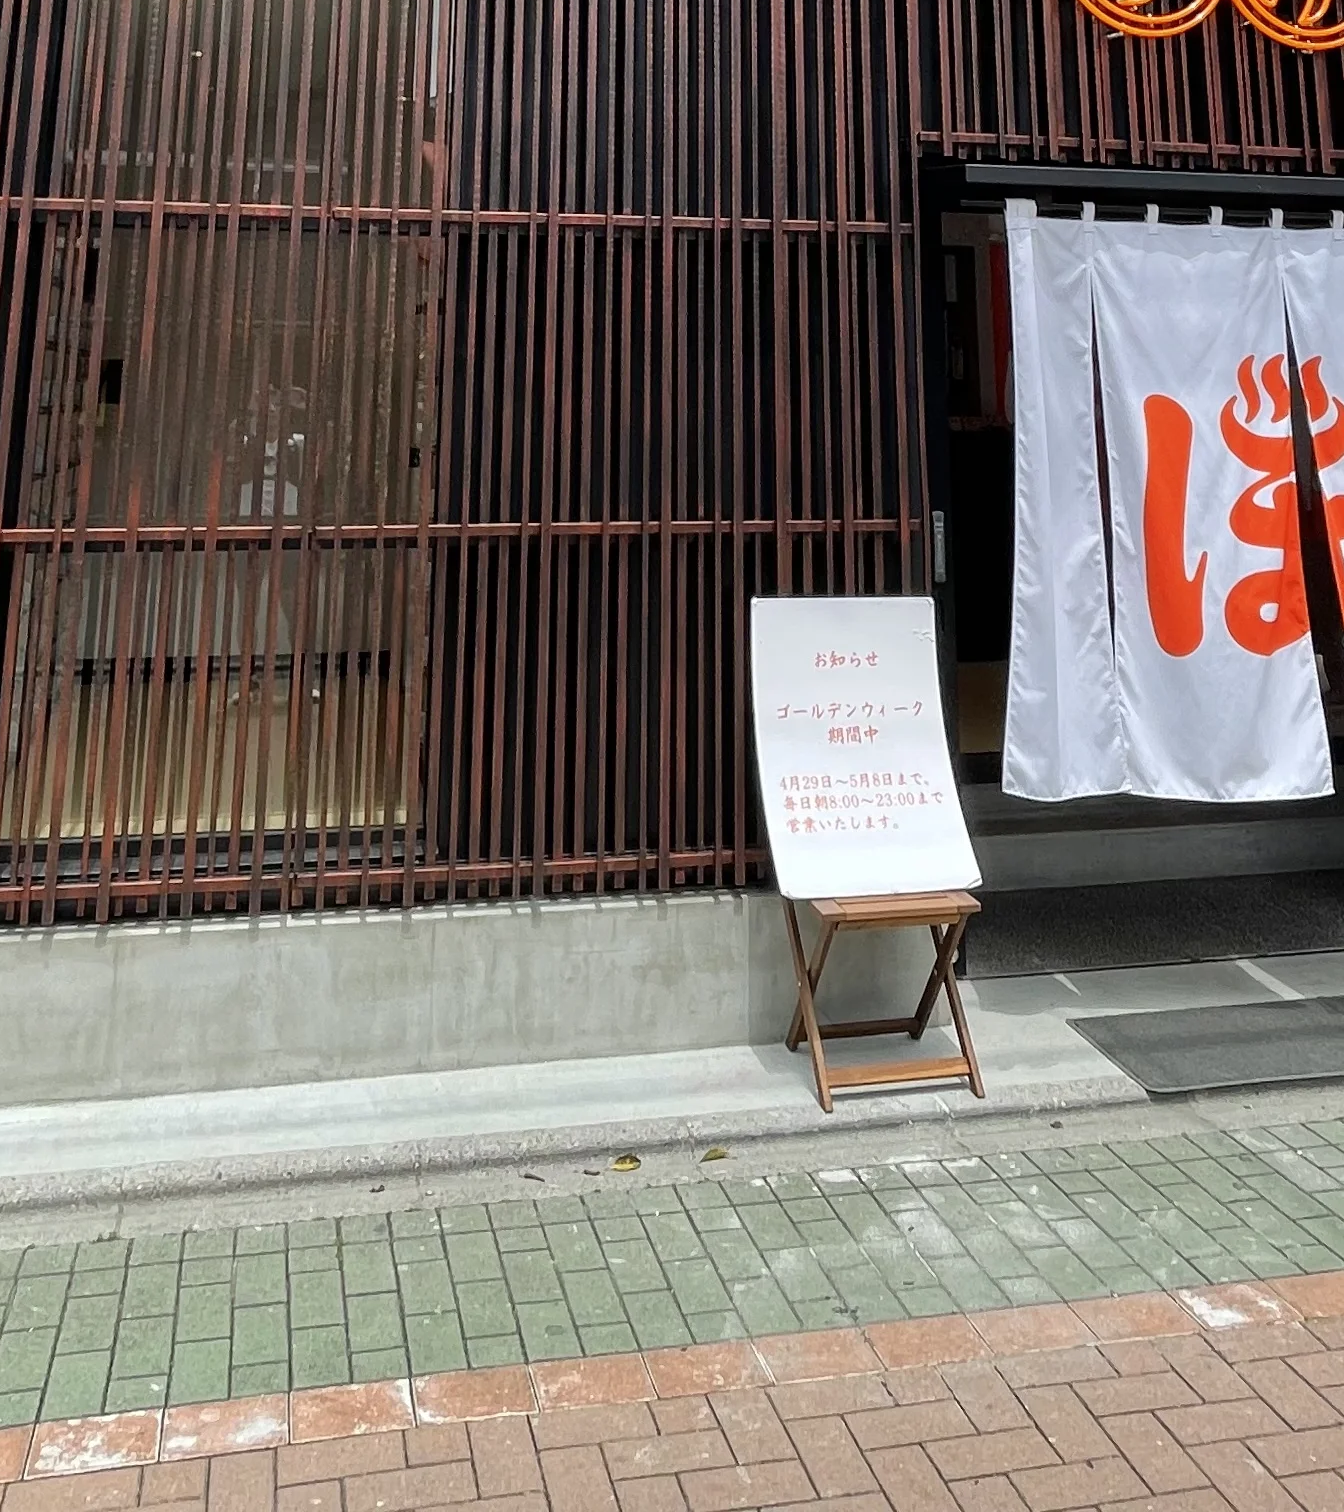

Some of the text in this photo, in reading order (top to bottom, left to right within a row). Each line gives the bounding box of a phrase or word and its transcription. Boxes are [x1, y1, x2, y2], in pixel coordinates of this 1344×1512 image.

[814, 650, 879, 668] お知らせ
[776, 700, 924, 720] ゴールデンウィーク
[828, 724, 879, 745] 期間中
[786, 815, 899, 834] 営業いたします。
